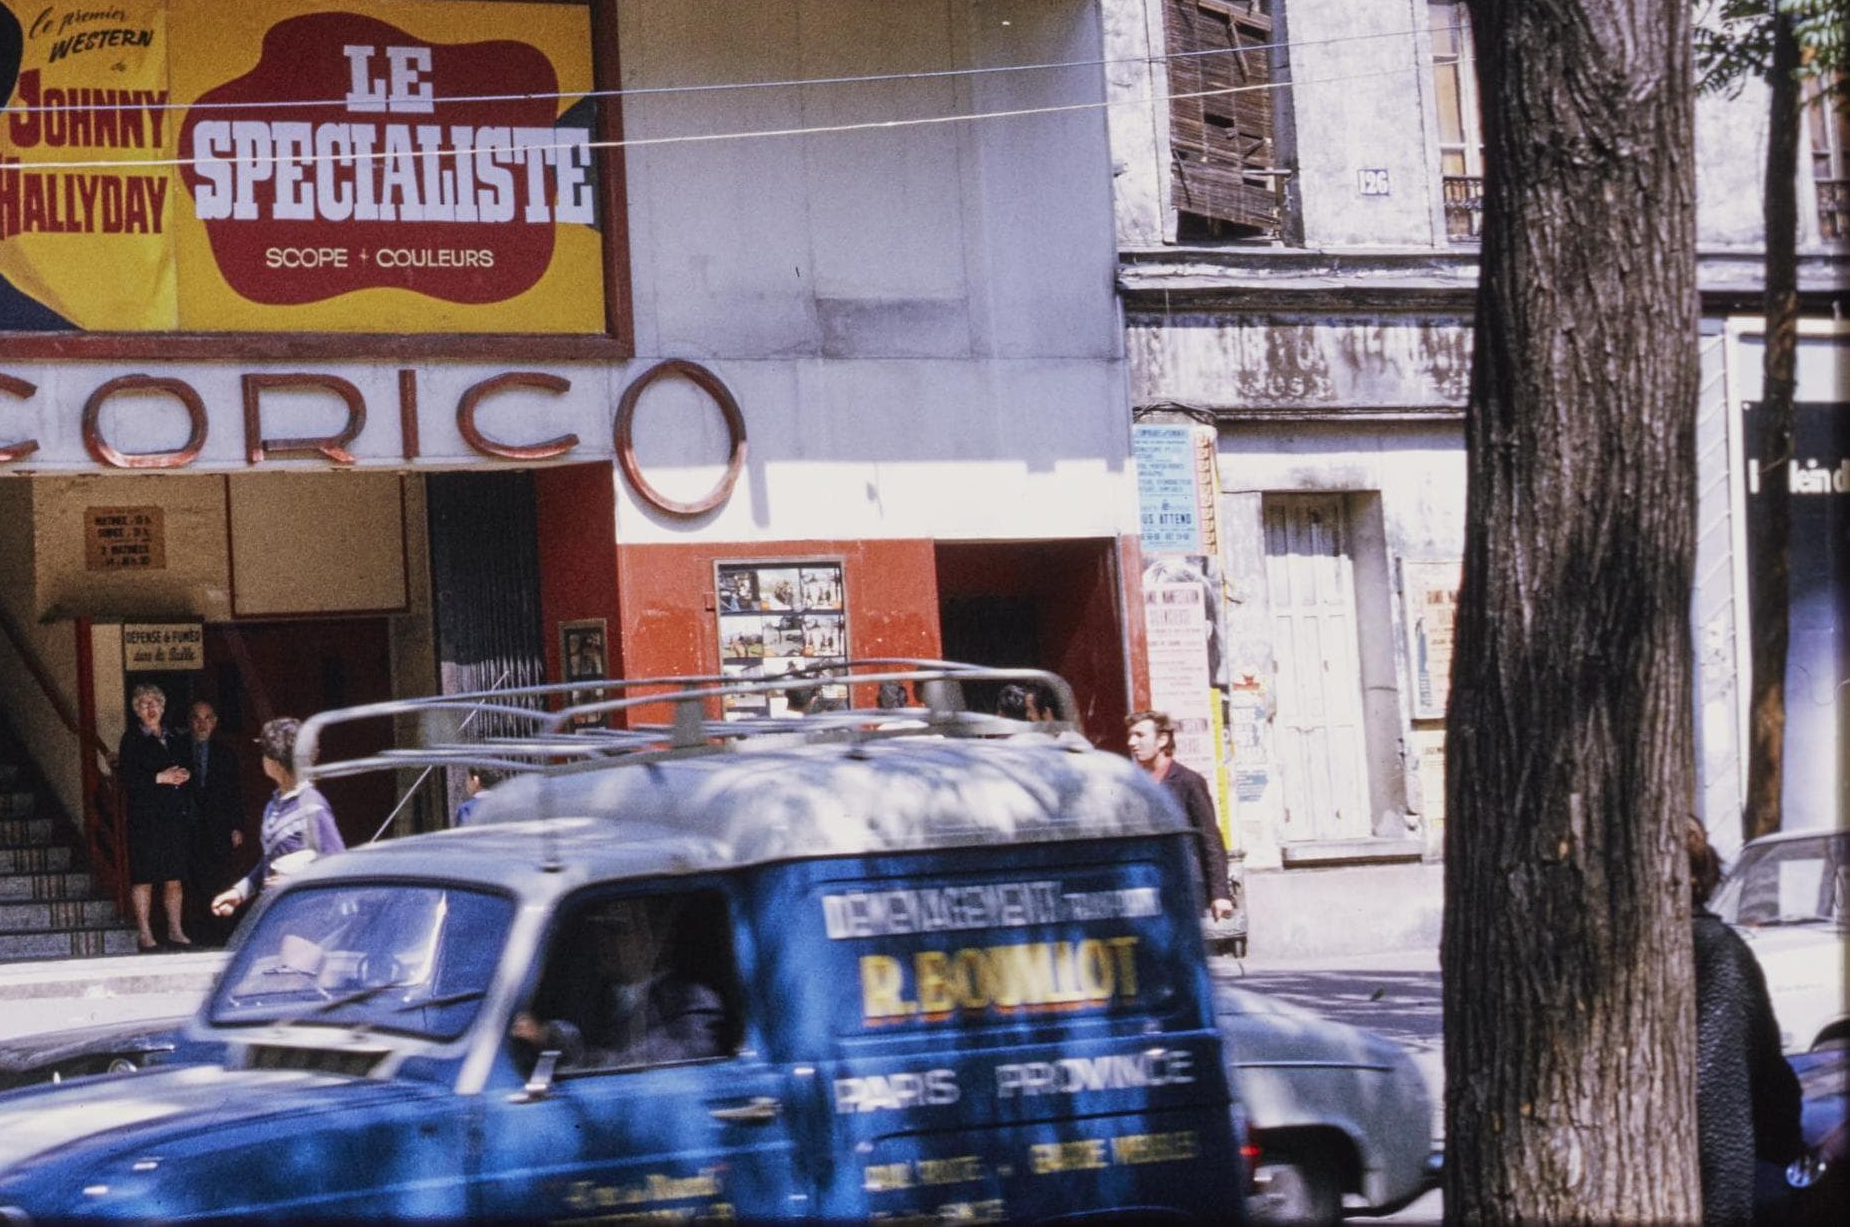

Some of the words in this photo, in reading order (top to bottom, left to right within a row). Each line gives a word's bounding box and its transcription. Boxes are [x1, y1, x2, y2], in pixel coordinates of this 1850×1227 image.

[59, 5, 129, 35] premier
[49, 29, 154, 63] WESTERN
[343, 45, 435, 113] LE
[9, 68, 169, 149] JOHNNY
[193, 120, 595, 225] SPECIALISTE
[1359, 170, 1388, 194] 126
[266, 247, 348, 268] SCOPE
[376, 247, 495, 268] COULEURS
[834, 1069, 961, 1114] PARIS
[995, 1050, 1196, 1099] PROVINCE
